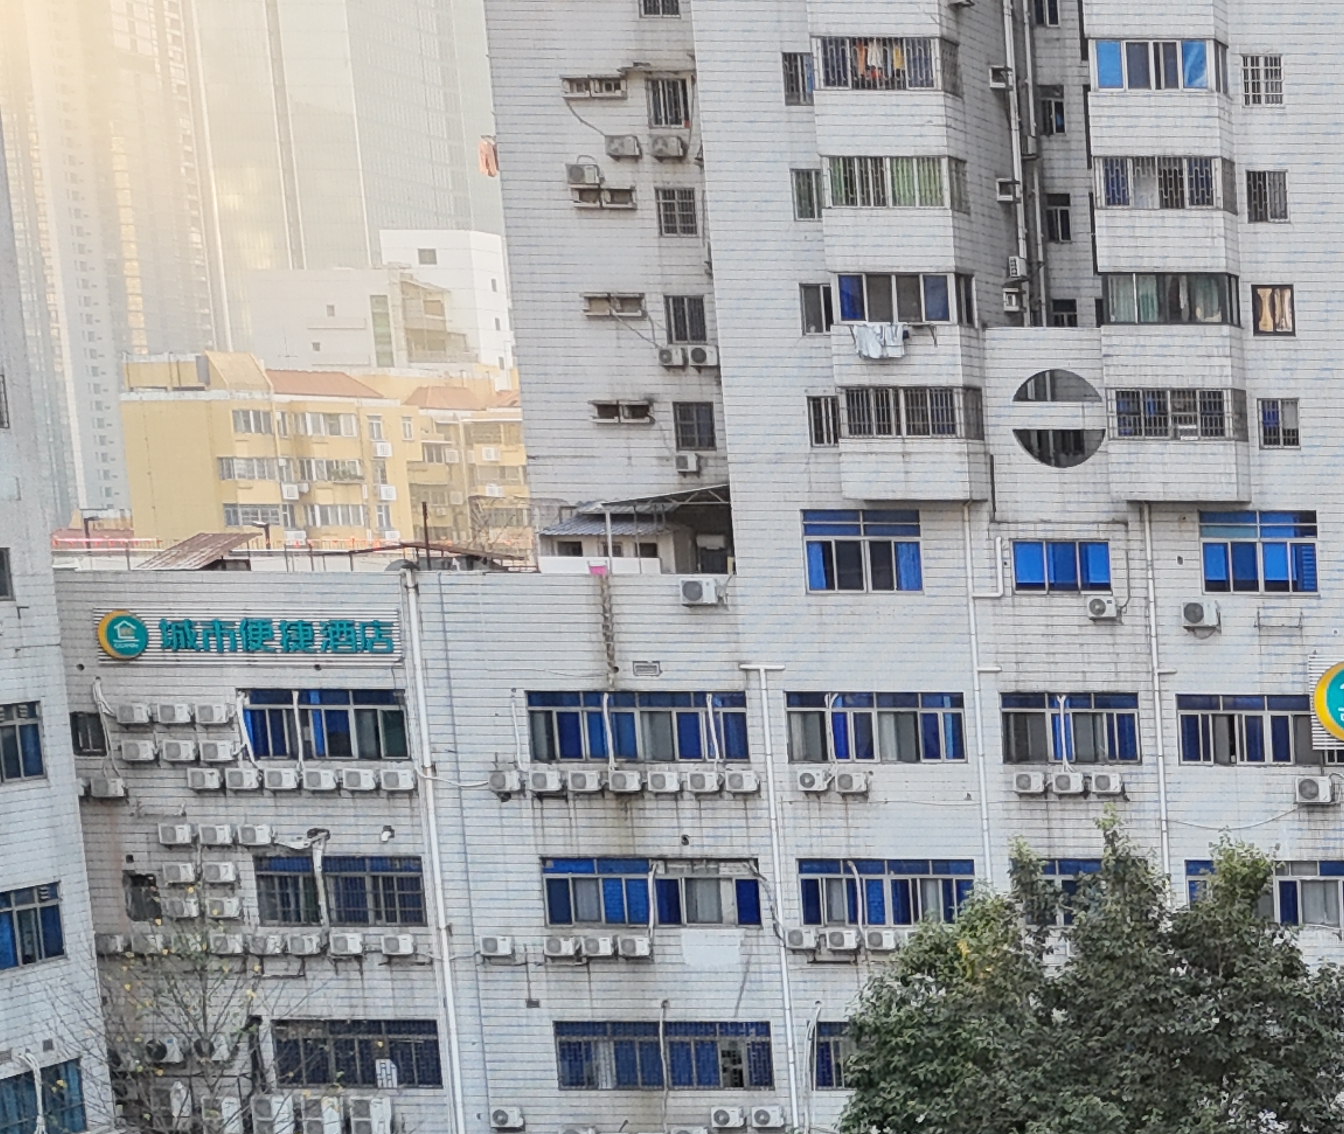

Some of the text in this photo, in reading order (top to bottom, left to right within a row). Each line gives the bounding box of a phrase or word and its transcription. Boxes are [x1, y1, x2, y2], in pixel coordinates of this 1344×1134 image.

[159, 618, 394, 654] 城市便捷酒店
